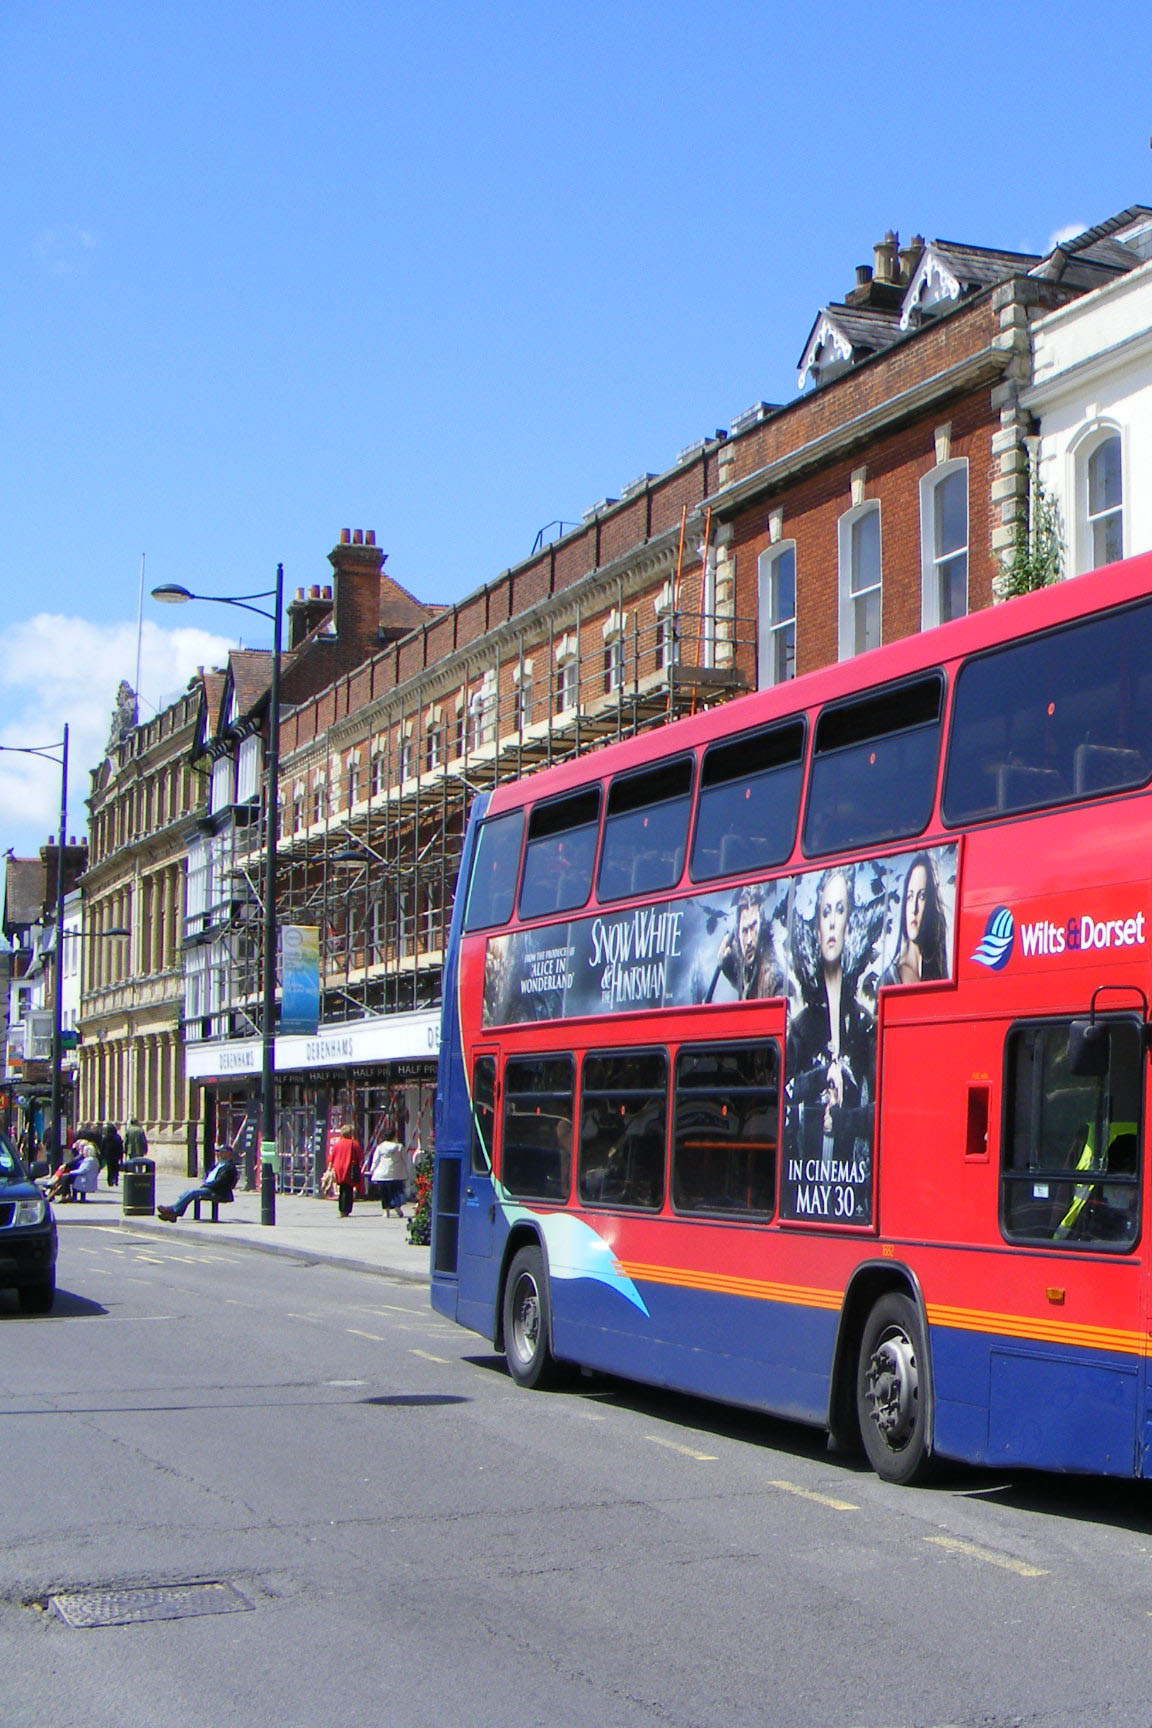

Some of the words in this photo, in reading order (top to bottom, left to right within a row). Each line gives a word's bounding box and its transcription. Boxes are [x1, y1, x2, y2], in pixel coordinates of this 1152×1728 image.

[589, 919, 635, 967] SNOW
[634, 908, 684, 959] WHITE
[1020, 920, 1066, 956] Wilts
[1080, 911, 1146, 950] Dorset
[556, 958, 566, 973] IN
[610, 962, 666, 1009] HUNTSMAN
[306, 1037, 353, 1062] DEBENHAMS
[353, 1068, 375, 1077] HALF
[398, 1065, 422, 1075] HALF
[788, 1159, 803, 1181] IN
[805, 1159, 866, 1183] CINEMAS
[796, 1184, 832, 1215] MAY
[834, 1185, 855, 1217] 30
